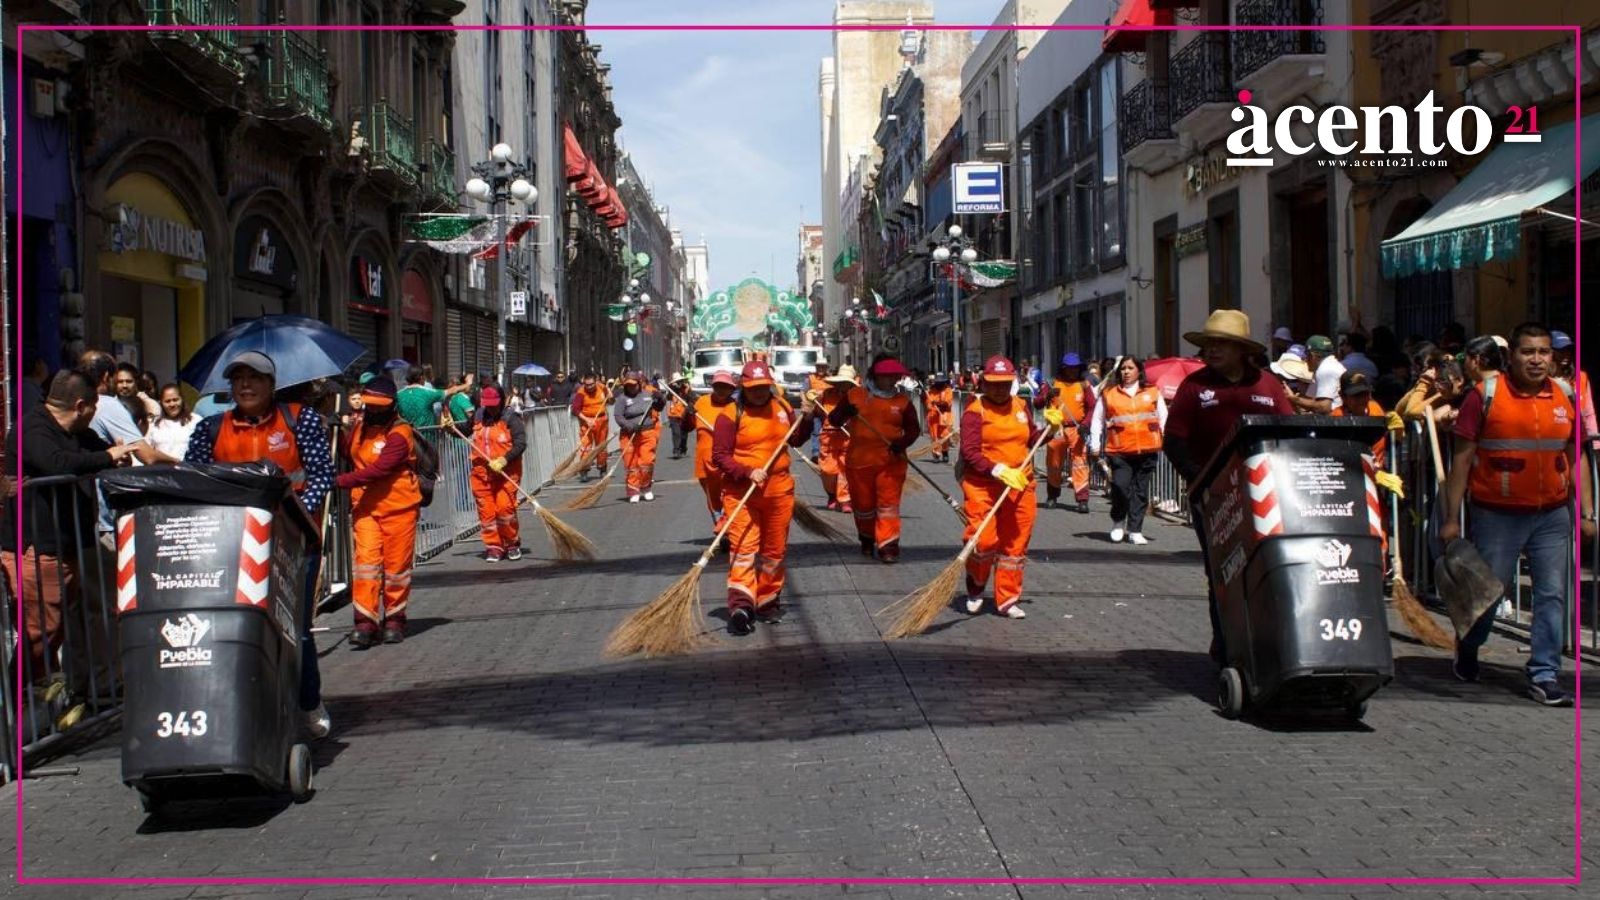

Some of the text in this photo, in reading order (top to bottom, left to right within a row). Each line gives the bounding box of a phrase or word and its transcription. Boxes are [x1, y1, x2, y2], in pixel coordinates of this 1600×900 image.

[956, 165, 1000, 203] E
[957, 203, 1000, 211] REFORMA
[144, 216, 206, 263] NUTRISA
[1300, 509, 1353, 517] IMPARABLE
[1316, 567, 1359, 580] Puebla
[156, 579, 220, 590] IMPARABLE
[1319, 618, 1362, 641] 349
[160, 647, 212, 663] Puebla
[157, 710, 208, 738] 343
